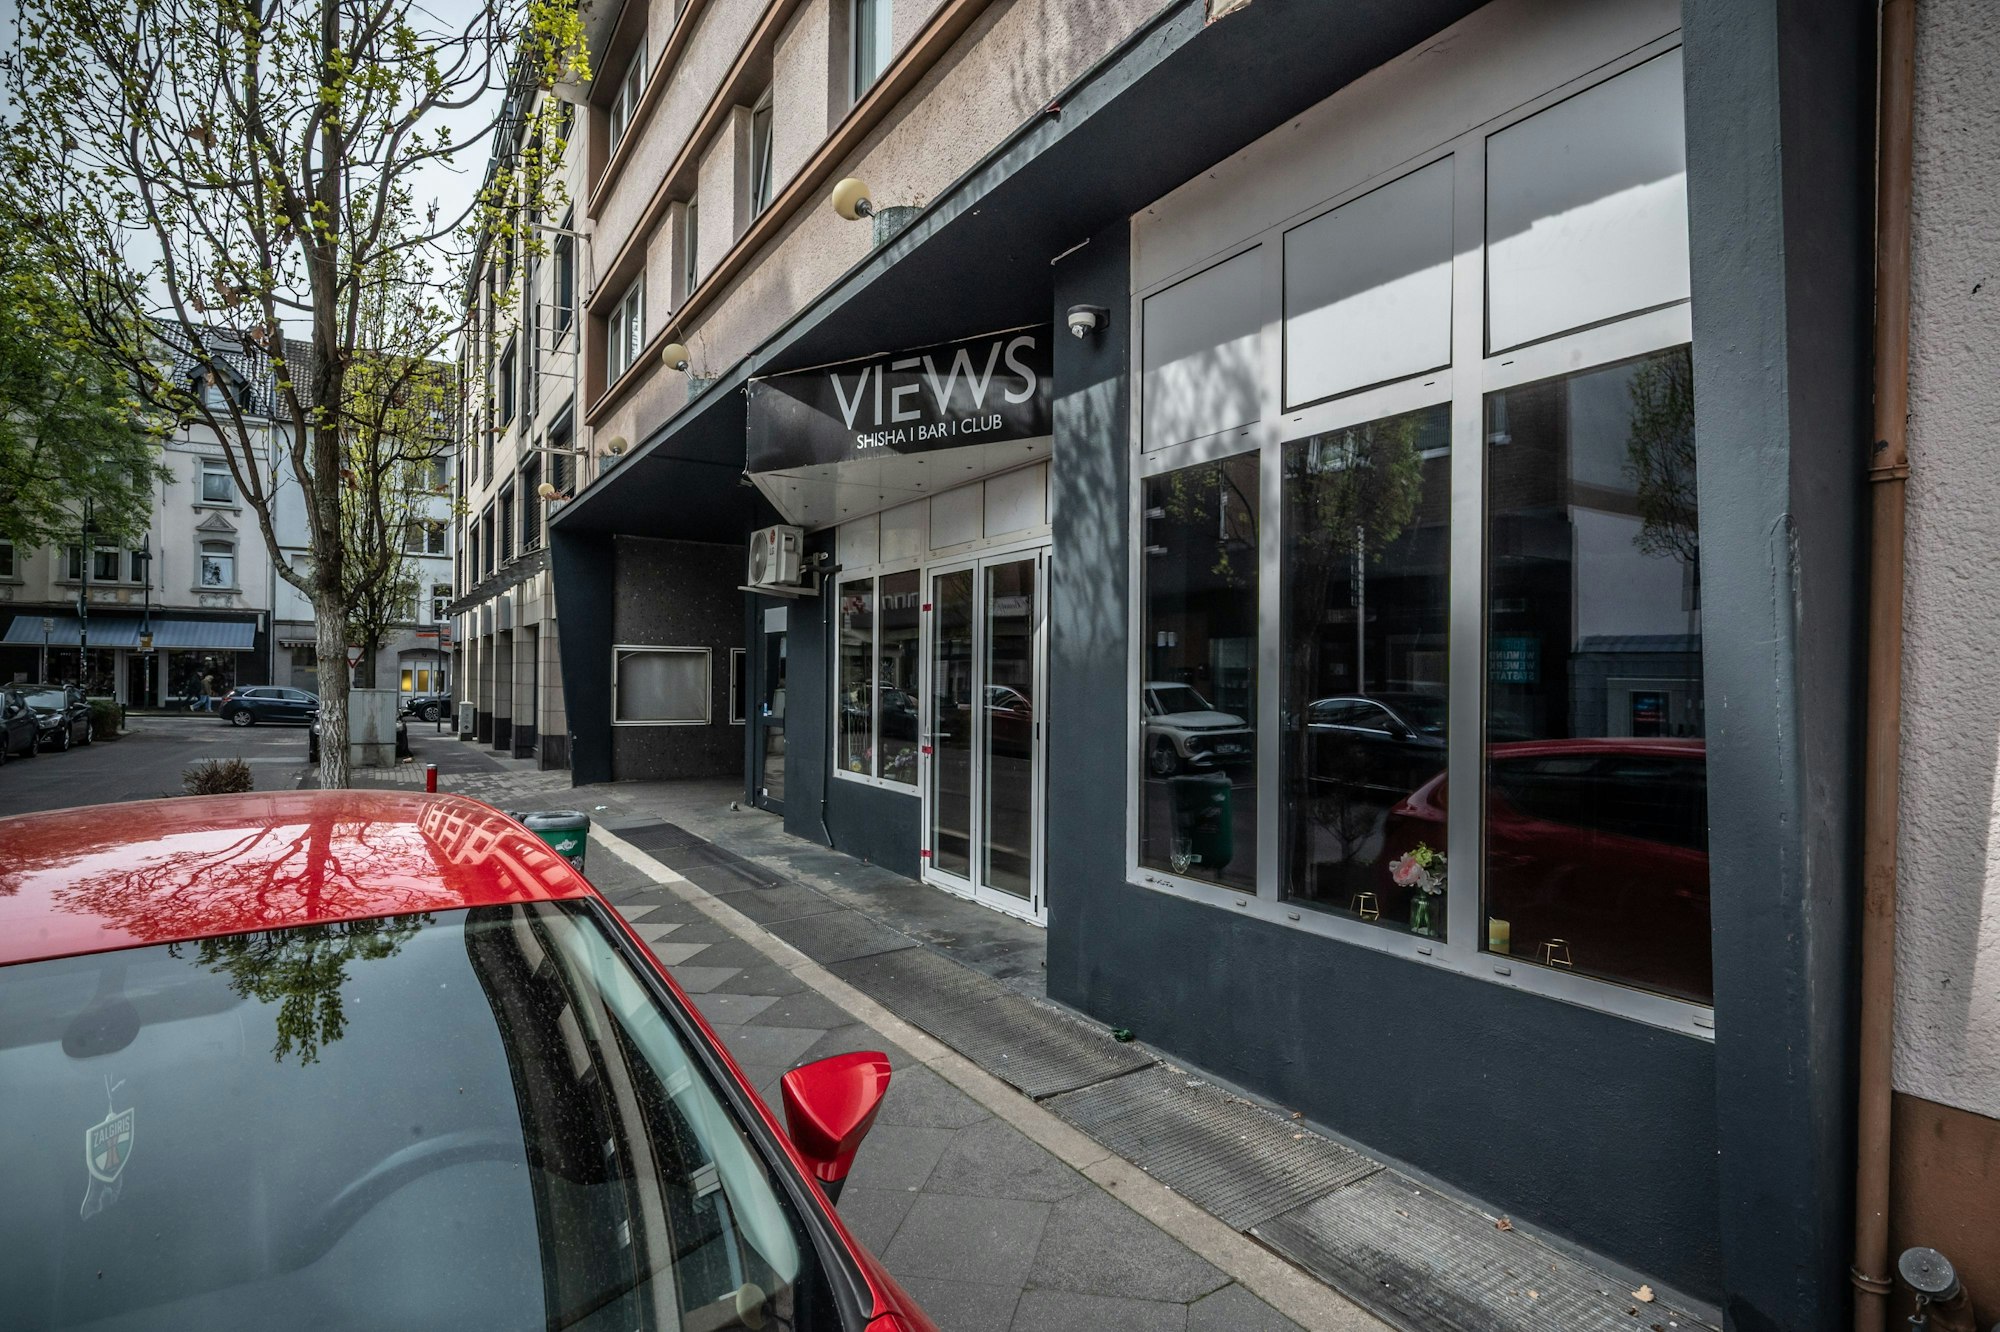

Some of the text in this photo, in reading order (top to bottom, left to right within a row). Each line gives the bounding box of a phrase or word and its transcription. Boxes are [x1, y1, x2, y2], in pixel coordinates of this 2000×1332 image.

[830, 335, 1037, 430] VIEWS
[856, 428, 906, 450] SHISHA
[918, 422, 948, 441] BAR
[961, 413, 1003, 435] CLUB
[93, 1115, 130, 1149] ZALGIRIS
